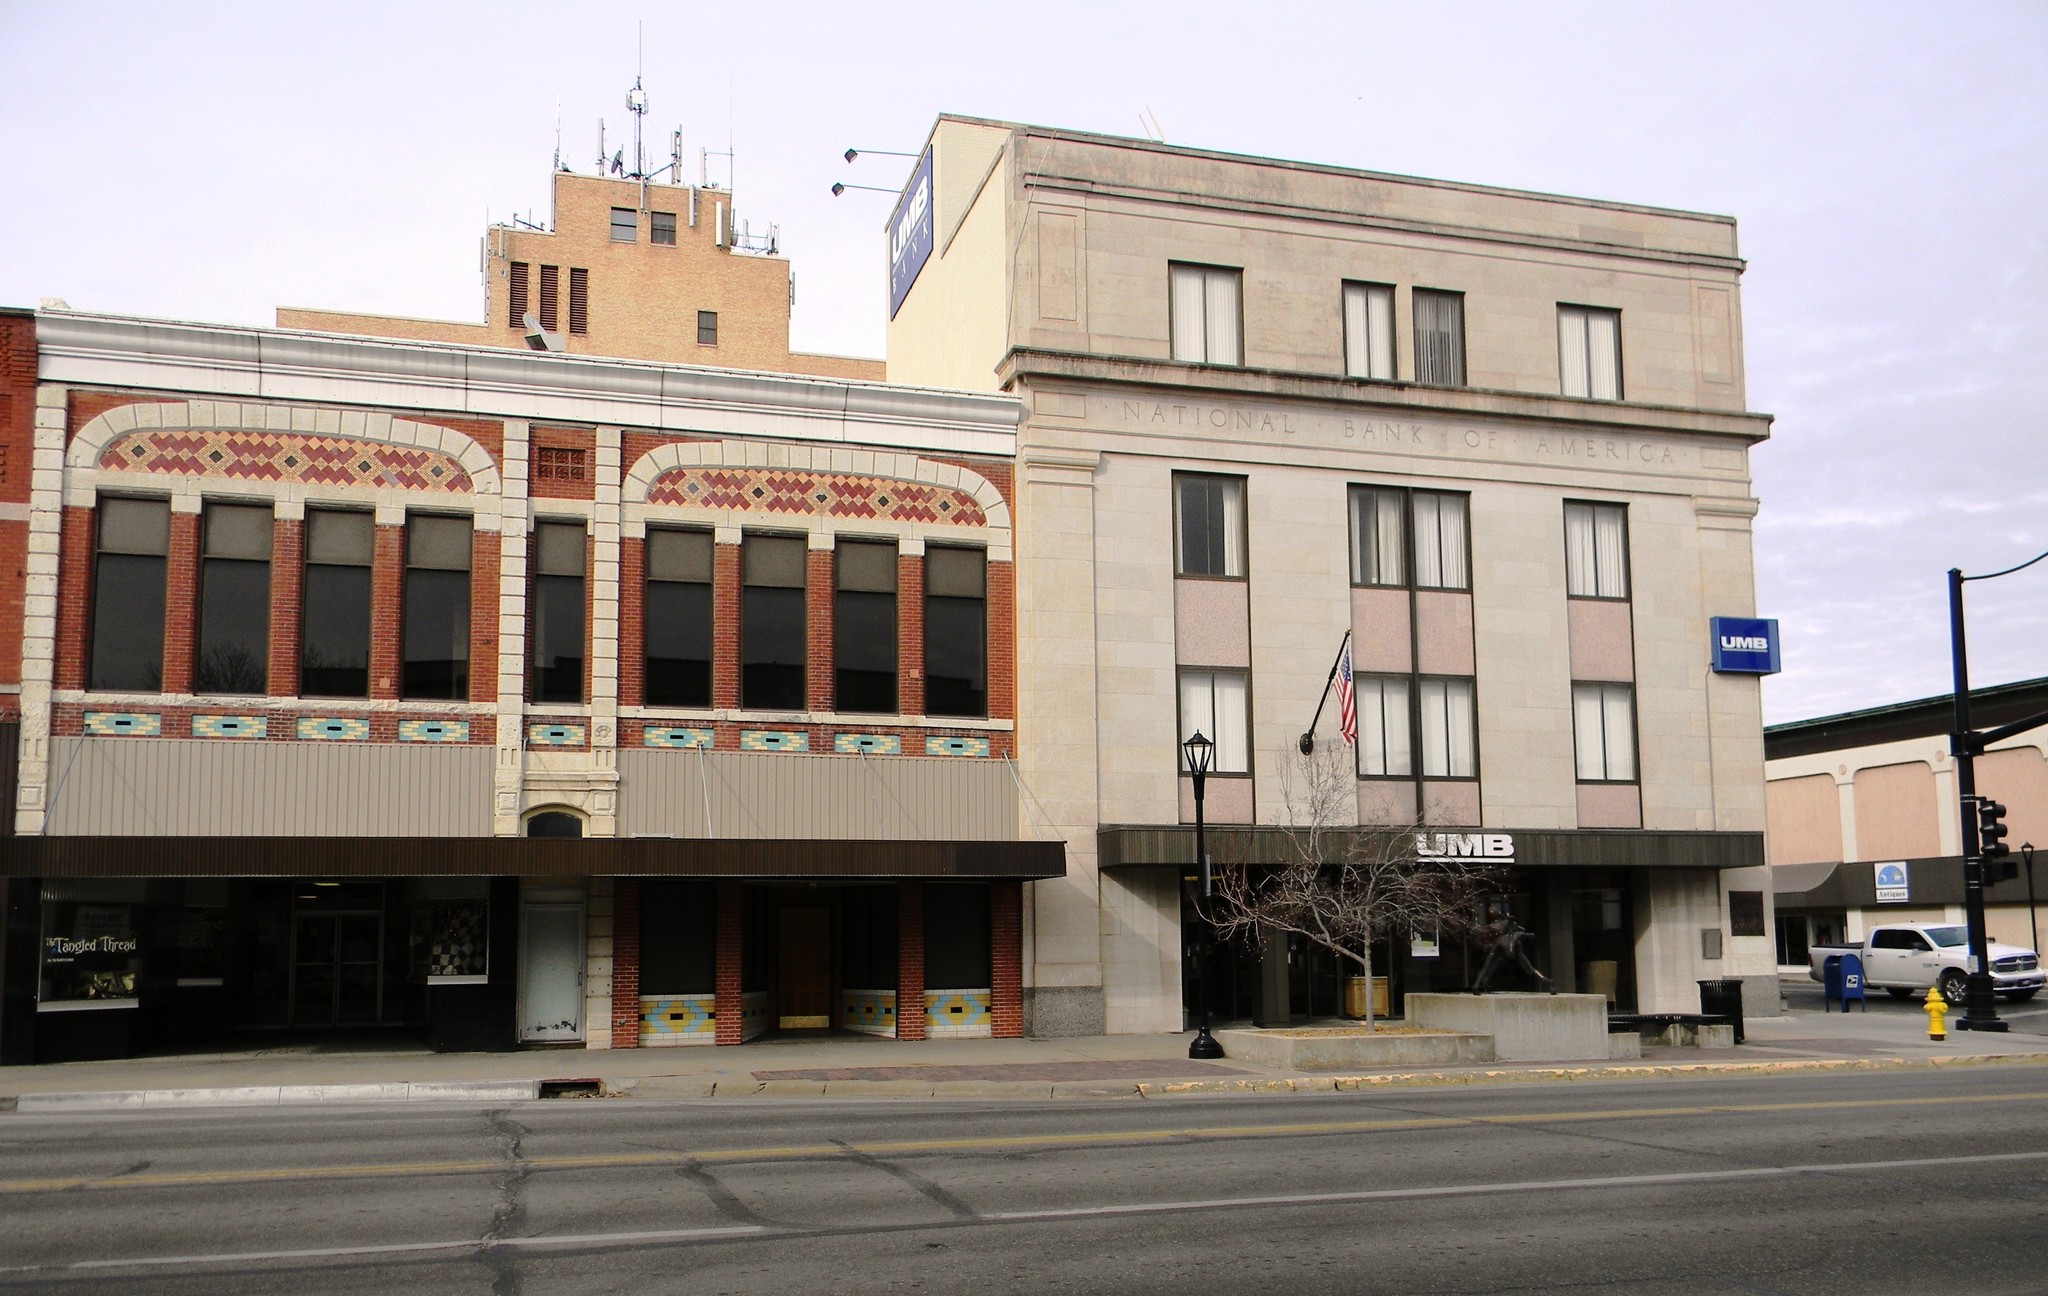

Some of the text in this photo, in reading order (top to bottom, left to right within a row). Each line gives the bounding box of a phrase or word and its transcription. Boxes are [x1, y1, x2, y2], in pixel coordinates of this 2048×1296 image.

[893, 175, 928, 264] UMB
[892, 219, 929, 296] BANK
[1123, 400, 1675, 464] NATIONAL BANK OF AMERICA
[1721, 636, 1768, 650] UMB
[1417, 833, 1514, 857] UMB
[1879, 890, 1905, 898] Antiques
[54, 937, 96, 954] Tangled
[100, 936, 136, 952] Thread
